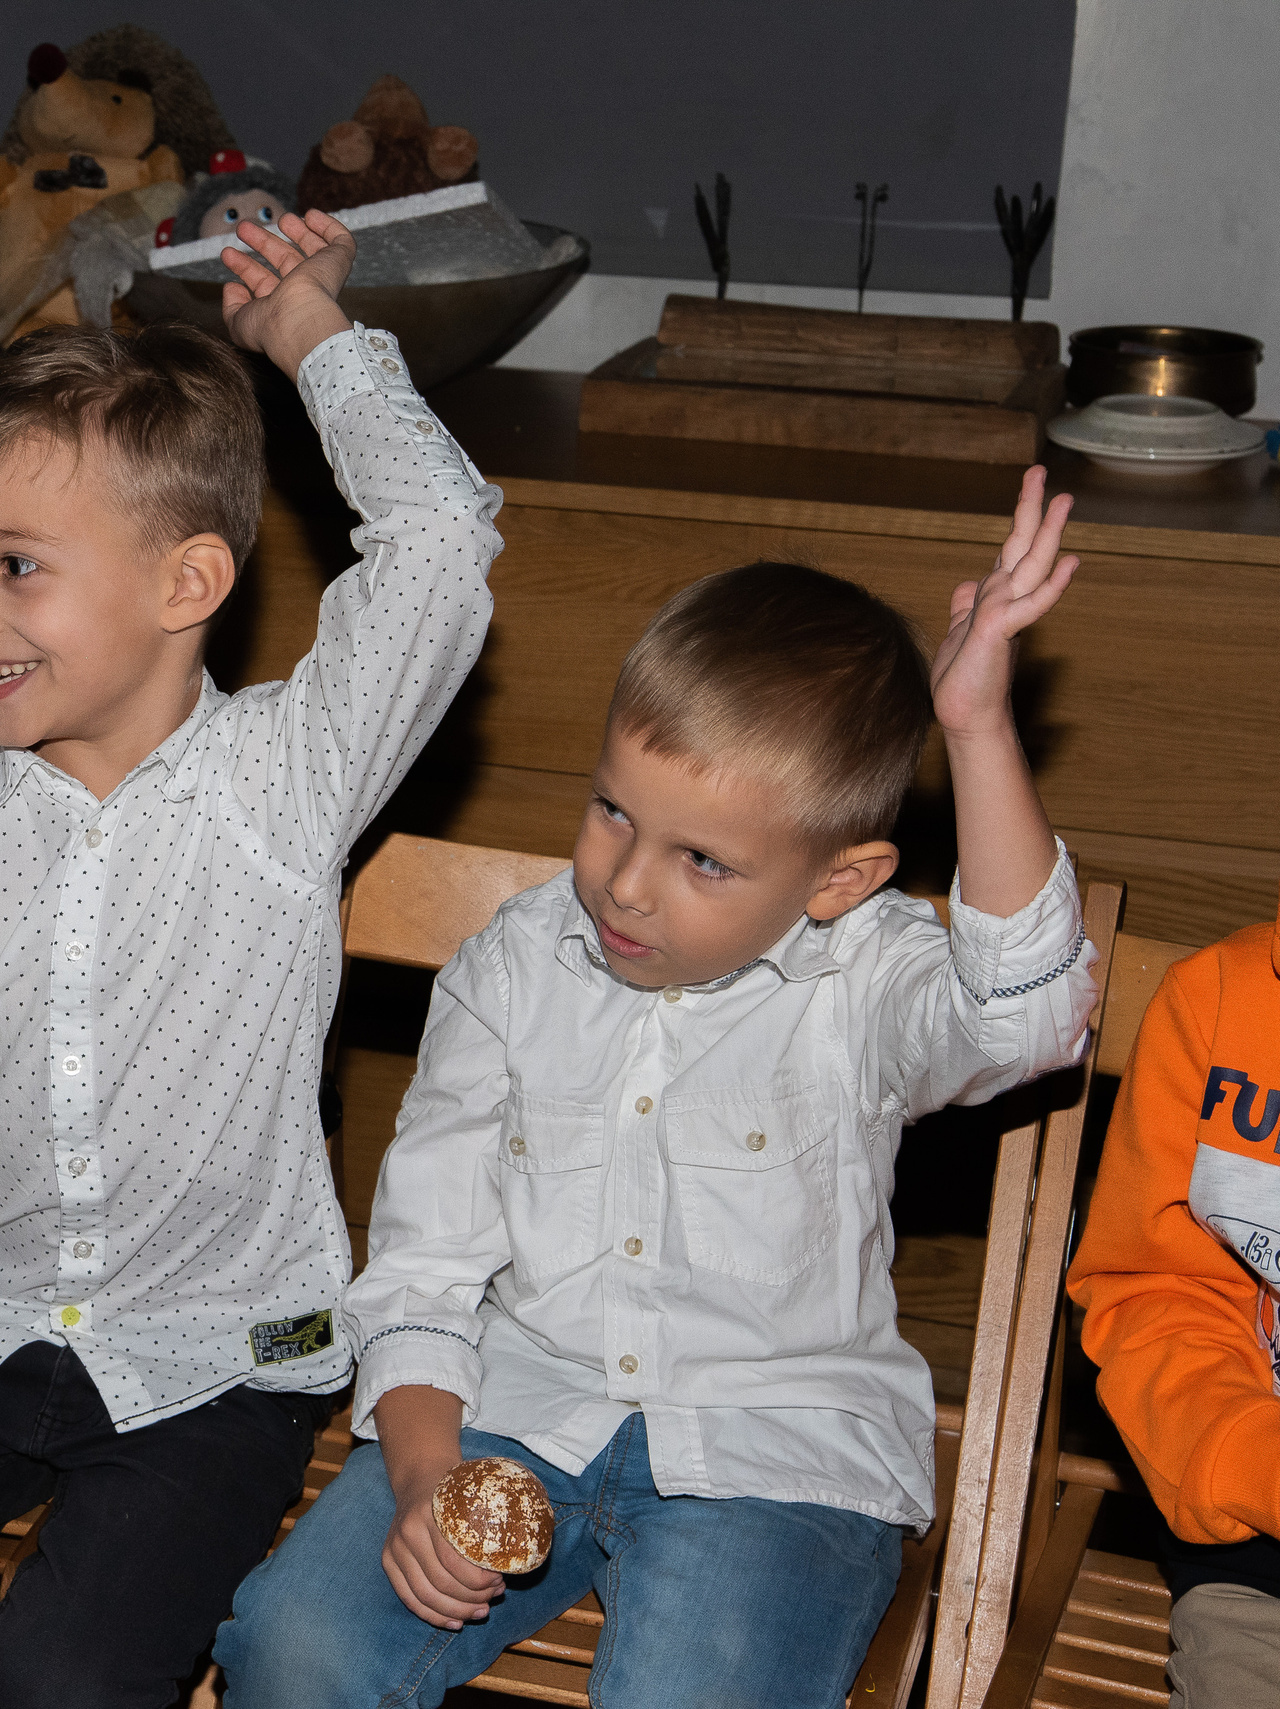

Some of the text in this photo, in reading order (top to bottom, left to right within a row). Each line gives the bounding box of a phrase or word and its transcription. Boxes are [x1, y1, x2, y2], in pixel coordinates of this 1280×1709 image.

[1200, 1066, 1280, 1155] FU
[252, 1321, 294, 1338] FOLLOW
[253, 1336, 272, 1348] THE
[255, 1341, 301, 1362] T-REX
